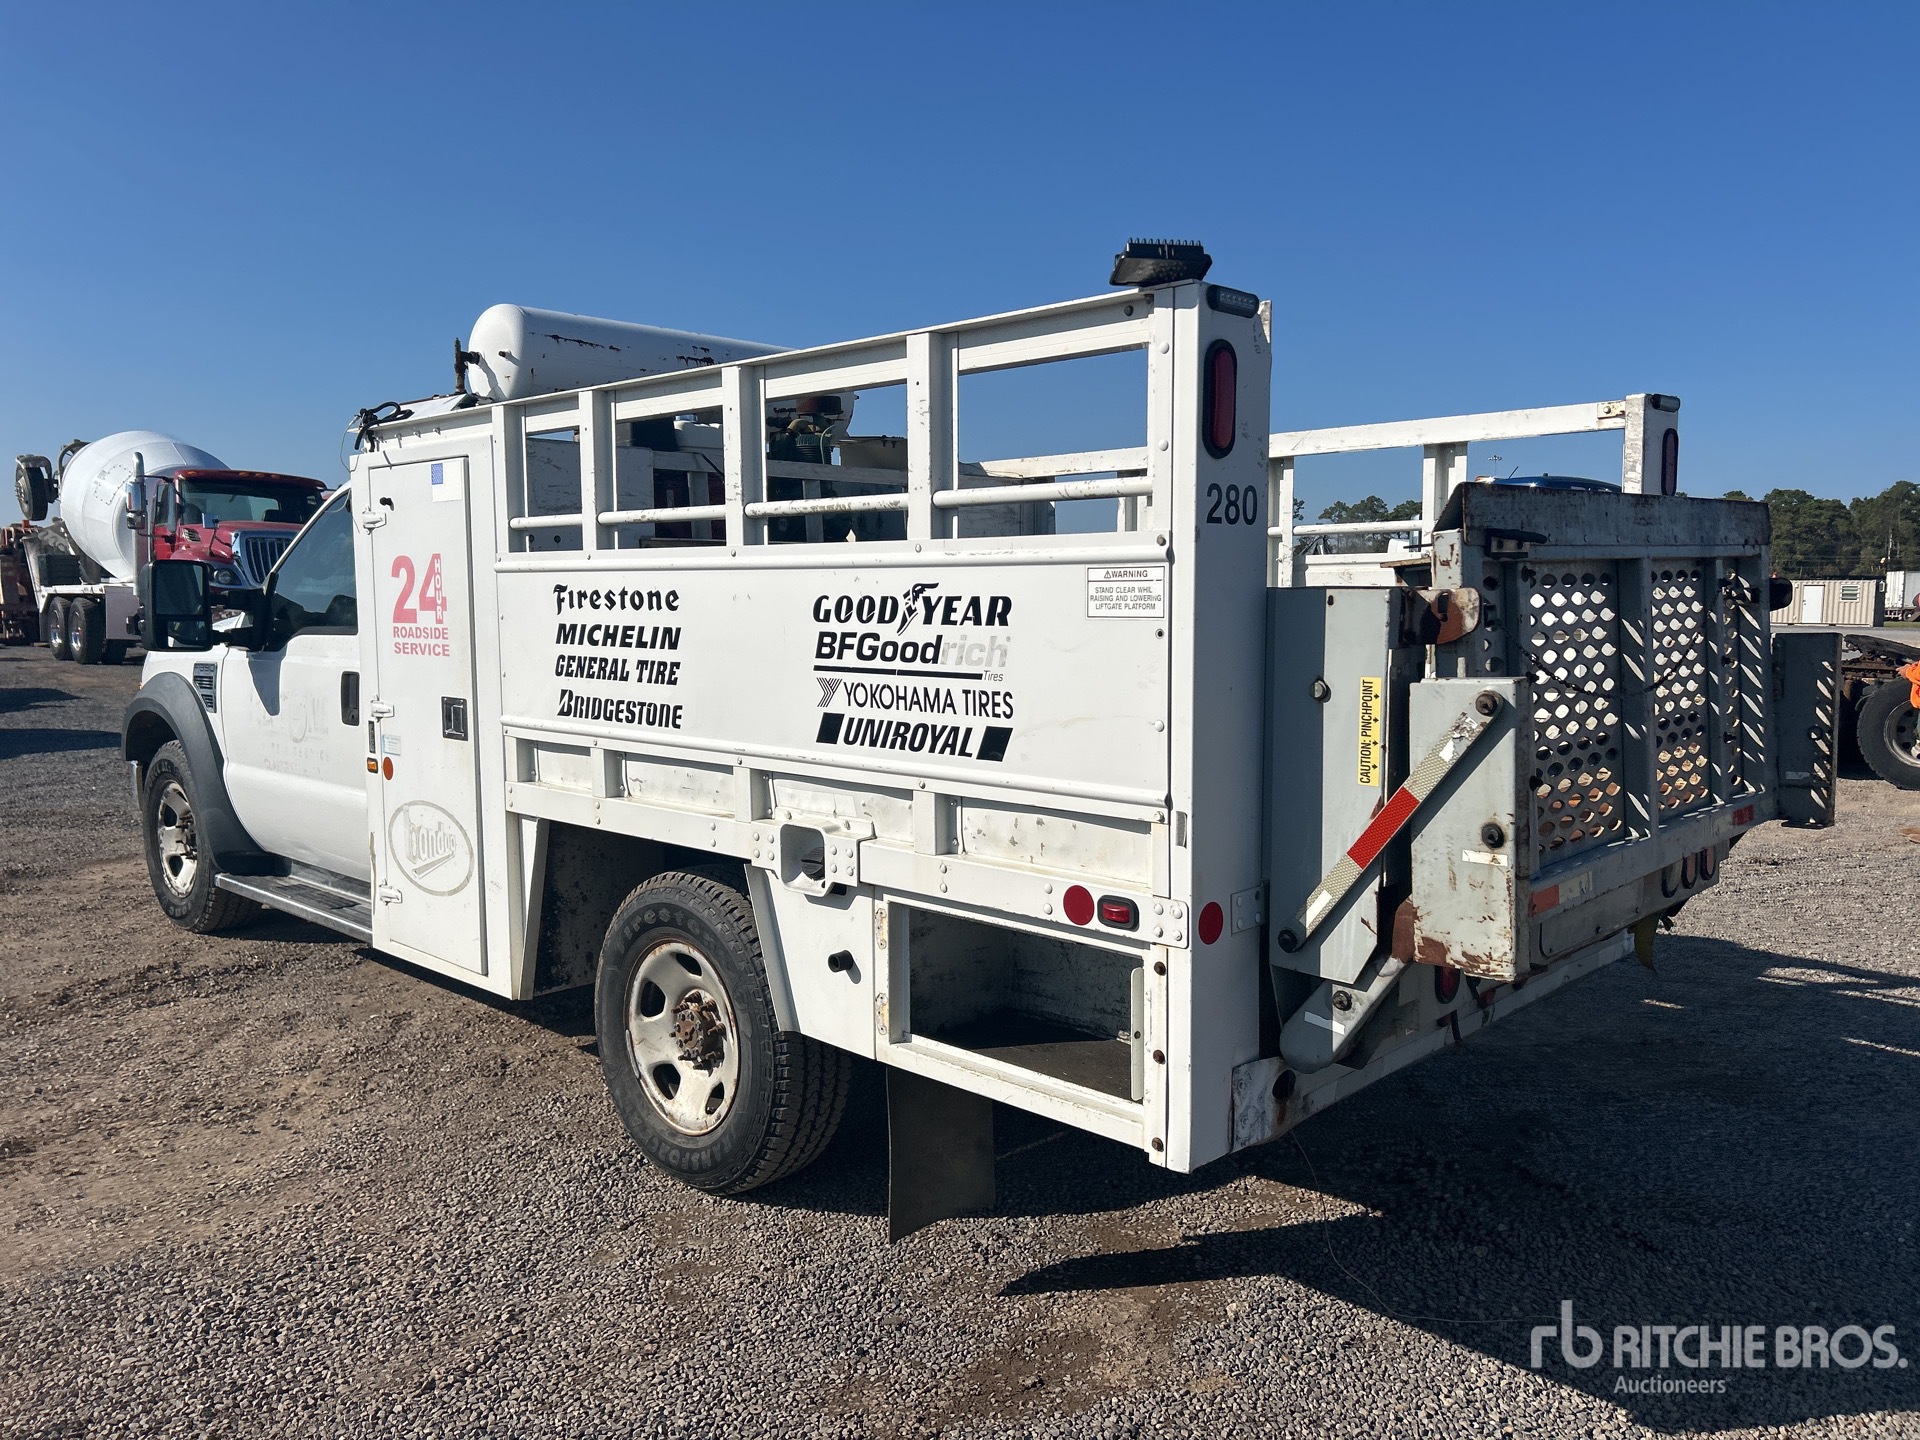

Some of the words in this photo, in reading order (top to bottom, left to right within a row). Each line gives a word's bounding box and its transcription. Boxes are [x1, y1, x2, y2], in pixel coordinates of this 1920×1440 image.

[1206, 483, 1258, 525] 280
[391, 553, 447, 624] 24
[434, 558, 443, 620] HOUR
[1111, 570, 1148, 578] WARNING
[553, 584, 680, 615] Firestone
[393, 626, 449, 640] ROADSIDE
[394, 641, 450, 657] SERVICE
[555, 623, 681, 650] MICHELIN
[555, 654, 630, 682] GENERAL
[636, 659, 681, 686] TIRE
[984, 669, 1004, 681] Tires
[557, 689, 683, 729] BRIDGESTONE
[843, 682, 957, 715] YOKOHAMA
[962, 689, 1014, 719] TIRES
[1361, 679, 1373, 737] PINCHPOINT
[843, 717, 973, 758] UNIROYAL
[1360, 739, 1372, 784] CAUTION:
